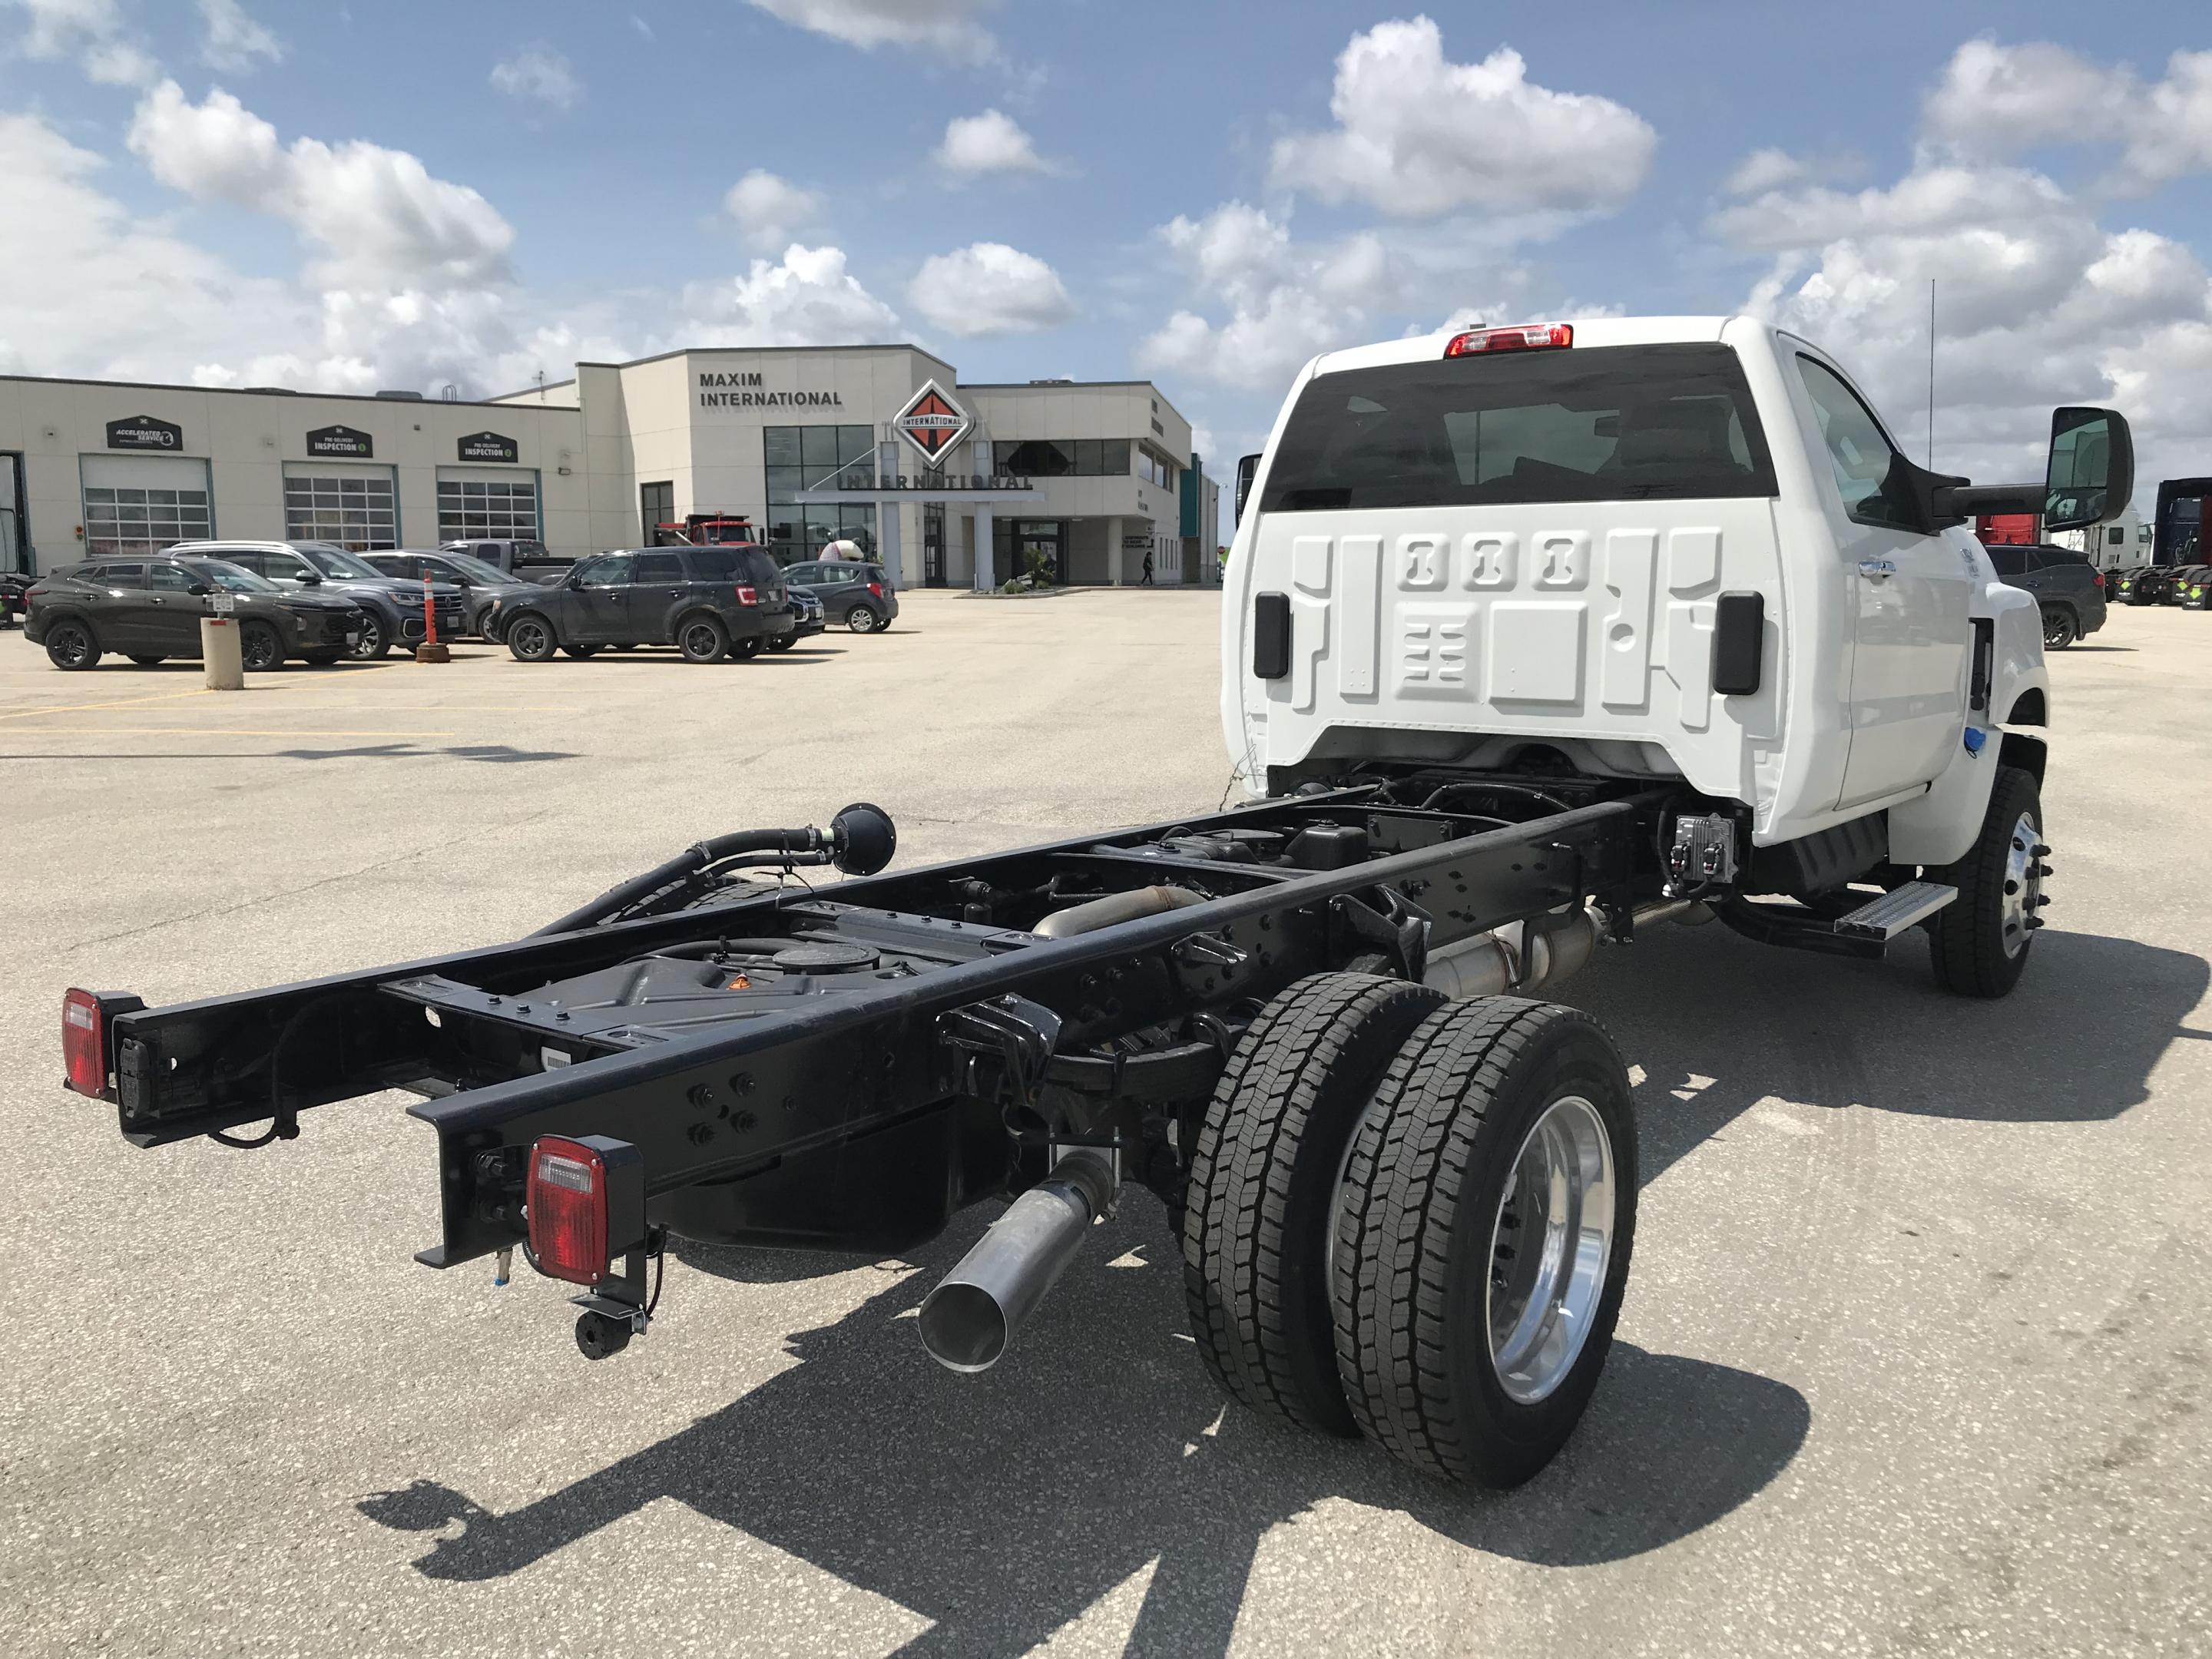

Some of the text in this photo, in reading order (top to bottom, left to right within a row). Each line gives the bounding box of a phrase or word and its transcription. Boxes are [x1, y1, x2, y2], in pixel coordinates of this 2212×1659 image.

[700, 373, 762, 386] MAXIM
[700, 392, 842, 406] INTERNATIONAL
[902, 416, 962, 426] INTERNATIONAL
[314, 442, 357, 451] INSPECTION
[465, 448, 504, 456] INSPECTION
[838, 474, 1033, 489] INTERNATIONAL
